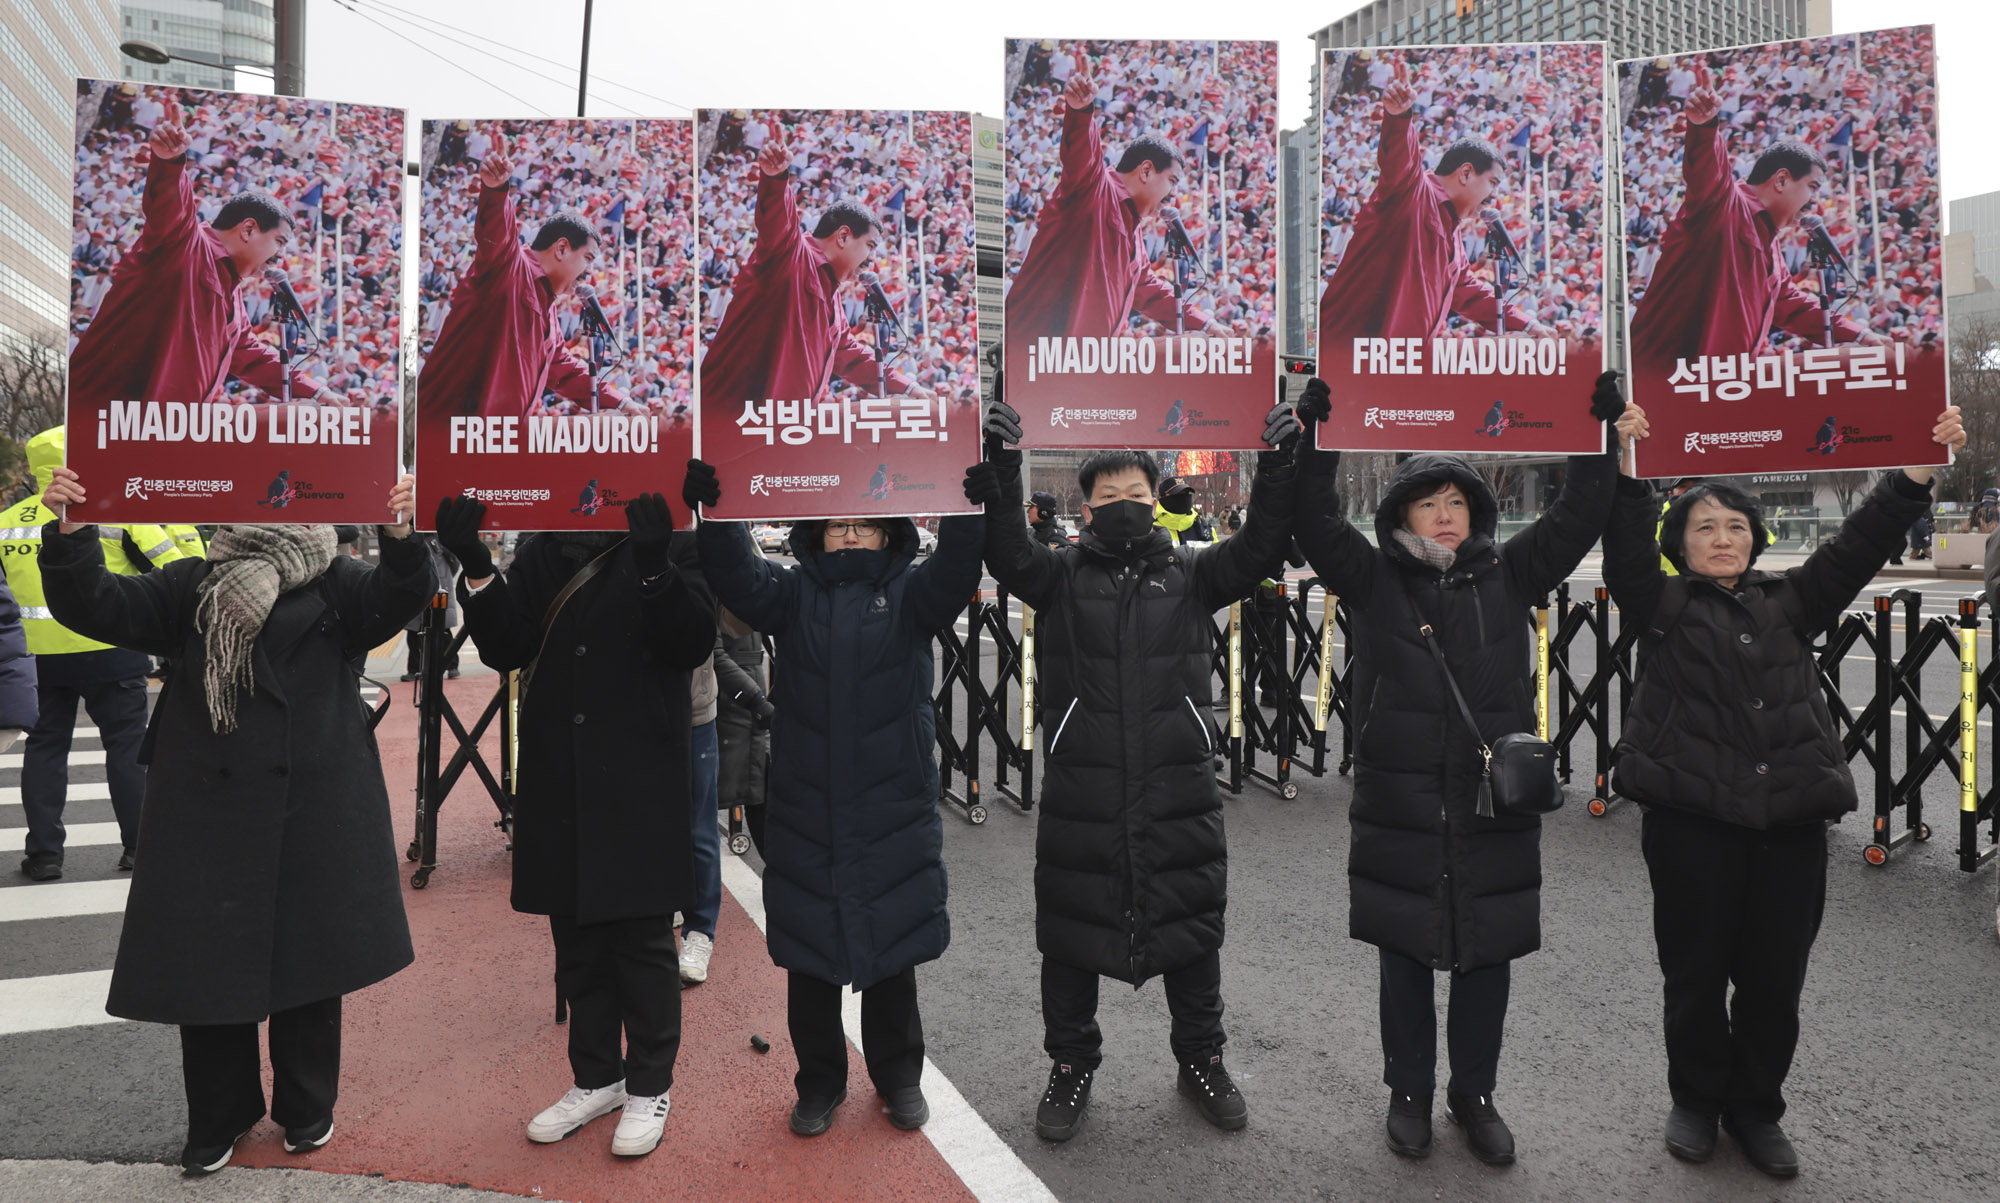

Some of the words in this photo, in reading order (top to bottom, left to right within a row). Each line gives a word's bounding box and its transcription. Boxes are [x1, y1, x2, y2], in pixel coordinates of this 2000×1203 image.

[1029, 337, 1156, 381] ¡MADURO
[1165, 337, 1252, 374] LIBRE!
[1353, 338, 1422, 374] FREE
[1432, 338, 1566, 376] MADURO!
[1668, 342, 1907, 402] 석방마두로!
[98, 400, 257, 449] ¡MADURO
[269, 405, 371, 445] LIBRE!
[735, 397, 948, 445] 석방마두로!
[1065, 409, 1137, 420] 민중민주당(민중당)
[1380, 410, 1454, 421] 민중민주당(민중당)
[450, 416, 518, 453] FREE
[528, 416, 658, 453] MADURO!
[1700, 429, 1782, 445] 민중민주당(민중당)
[144, 480, 233, 492] 민중민주당(민중당)
[477, 489, 550, 500] 민중민주당(민중당)
[765, 475, 840, 487] 민중민주당(민중당)
[1326, 619, 1334, 672] POLICE
[1960, 661, 1972, 792] 질서유지선
